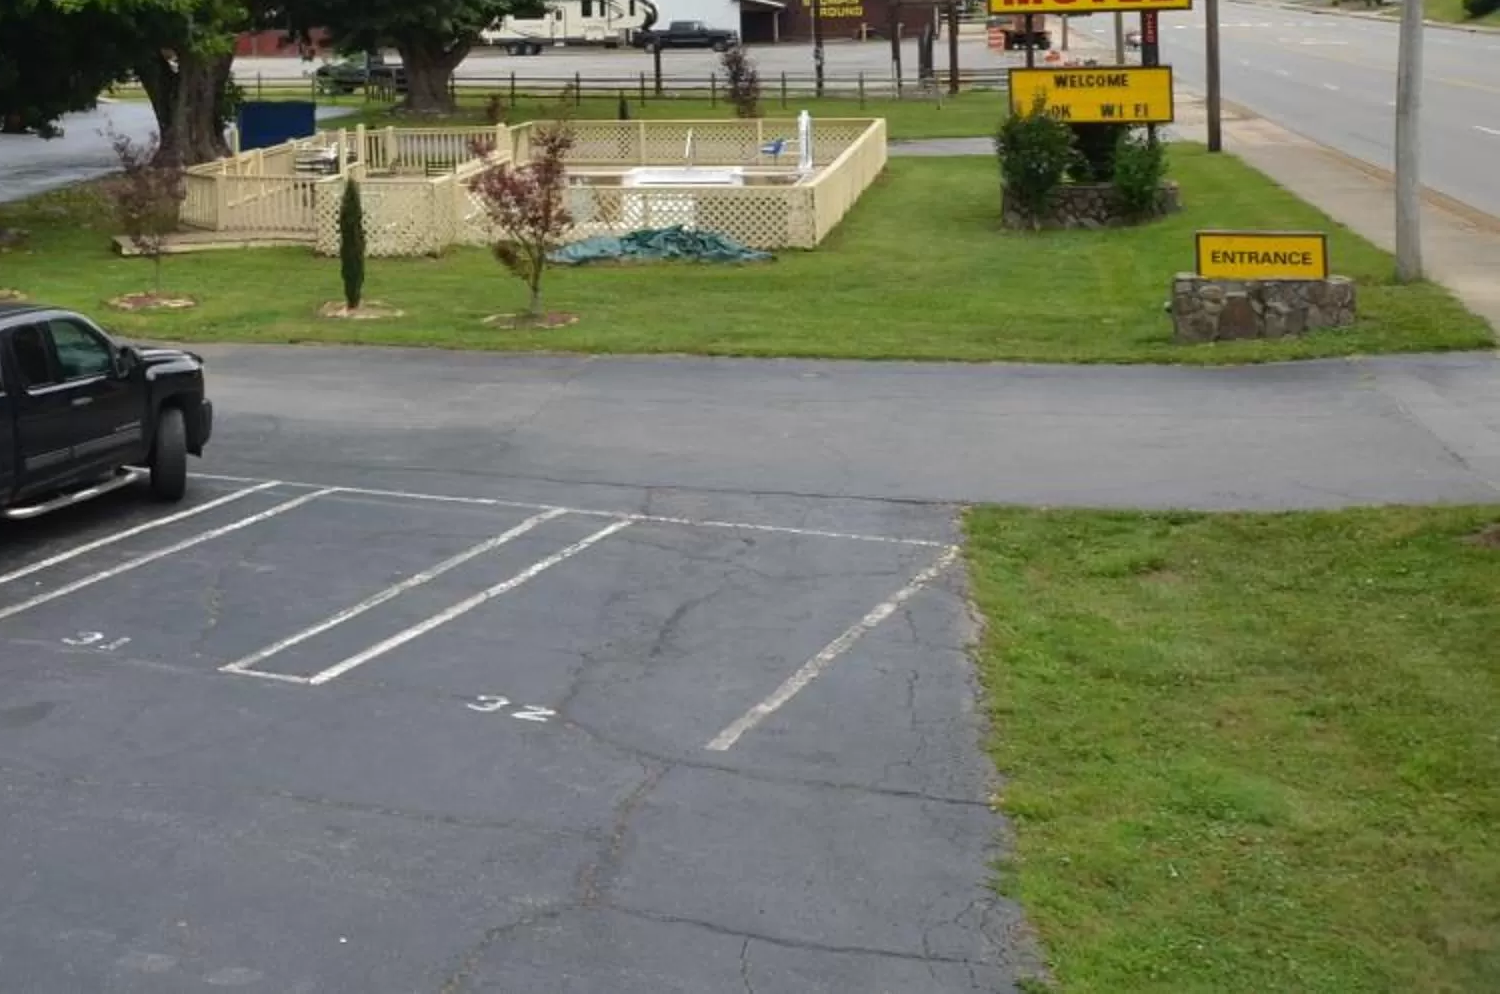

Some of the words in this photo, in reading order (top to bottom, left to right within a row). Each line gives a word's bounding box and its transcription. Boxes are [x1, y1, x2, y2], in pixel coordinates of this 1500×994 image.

[812, 5, 863, 18] ROUND
[1054, 74, 1129, 88] WELCOME
[1211, 250, 1313, 266] ENTRANCE
